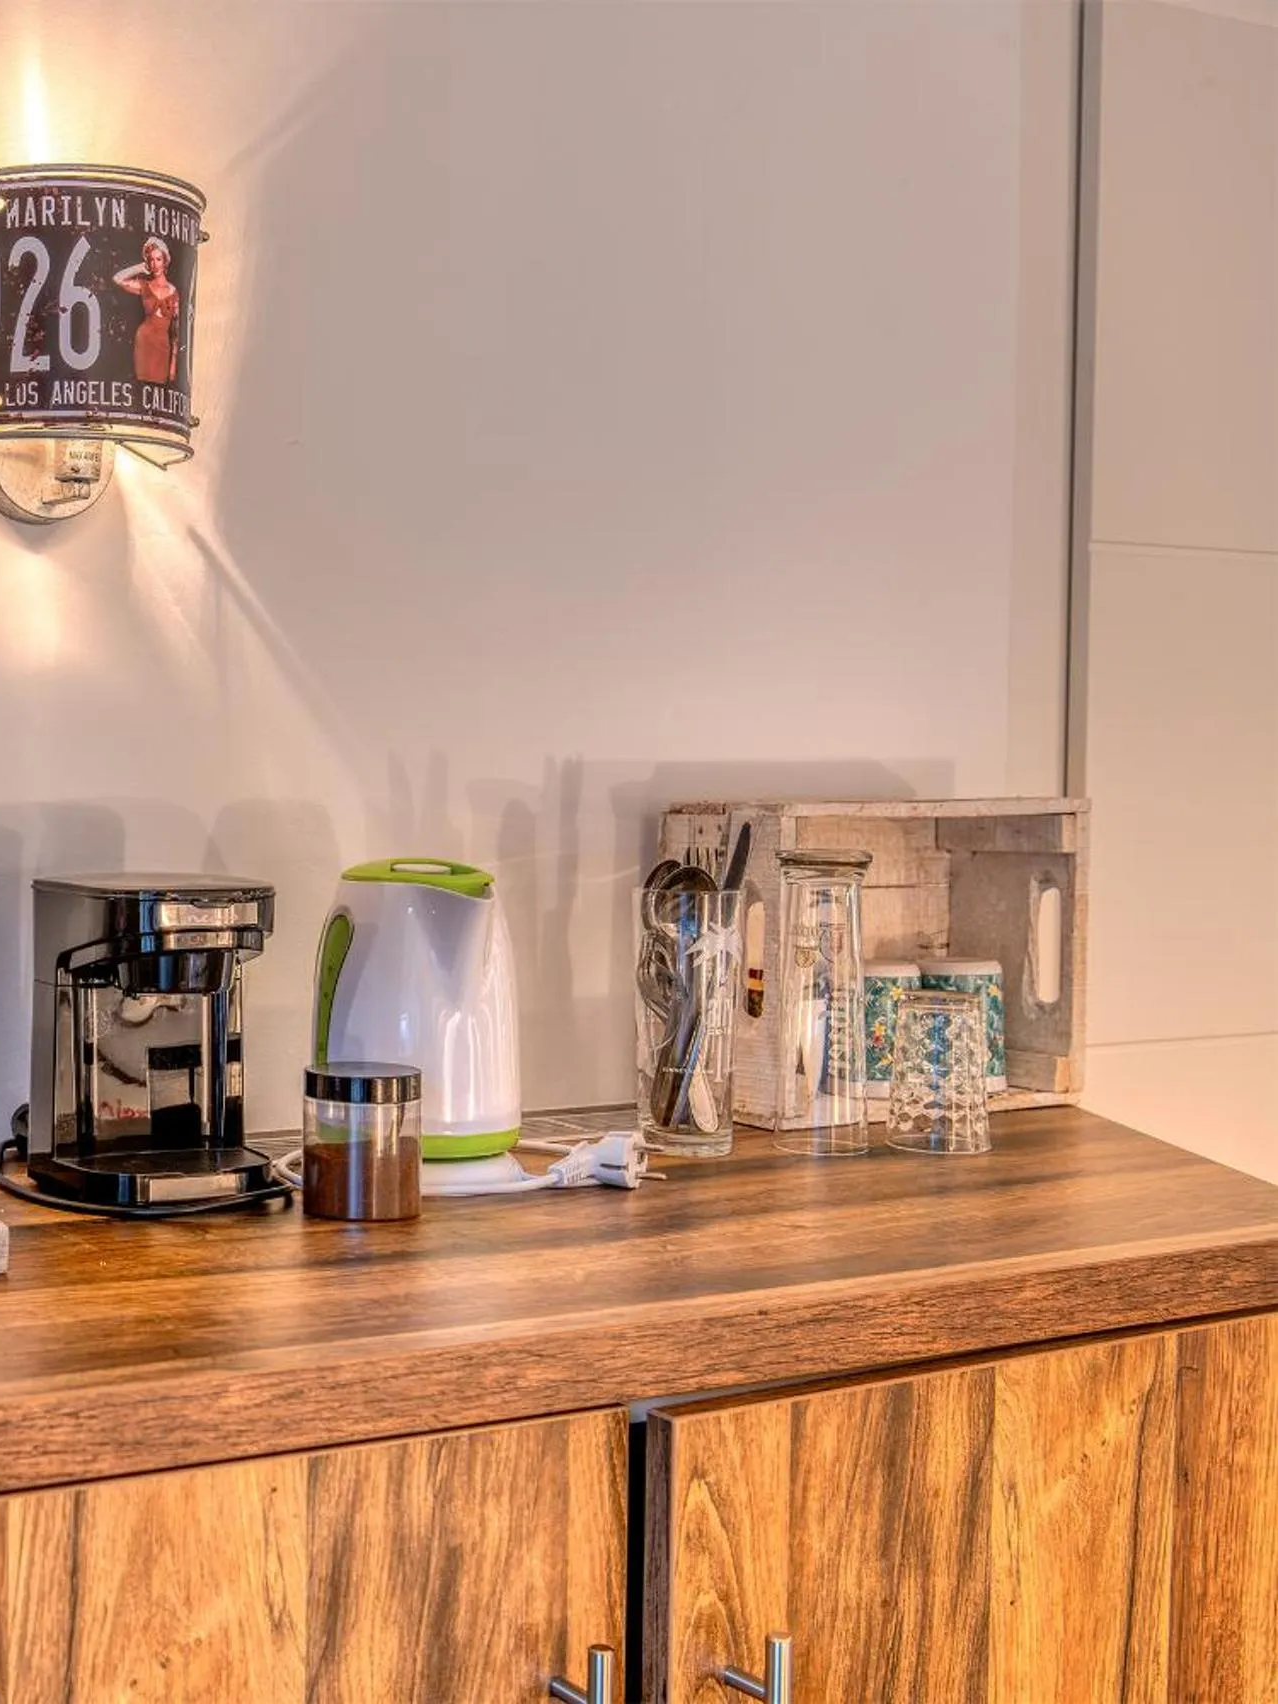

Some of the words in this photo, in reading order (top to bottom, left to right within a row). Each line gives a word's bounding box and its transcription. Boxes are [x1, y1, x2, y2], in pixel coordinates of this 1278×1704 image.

[6, 195, 126, 229] MARILYN
[5, 381, 39, 406] LOS
[52, 381, 133, 407] ANGELES
